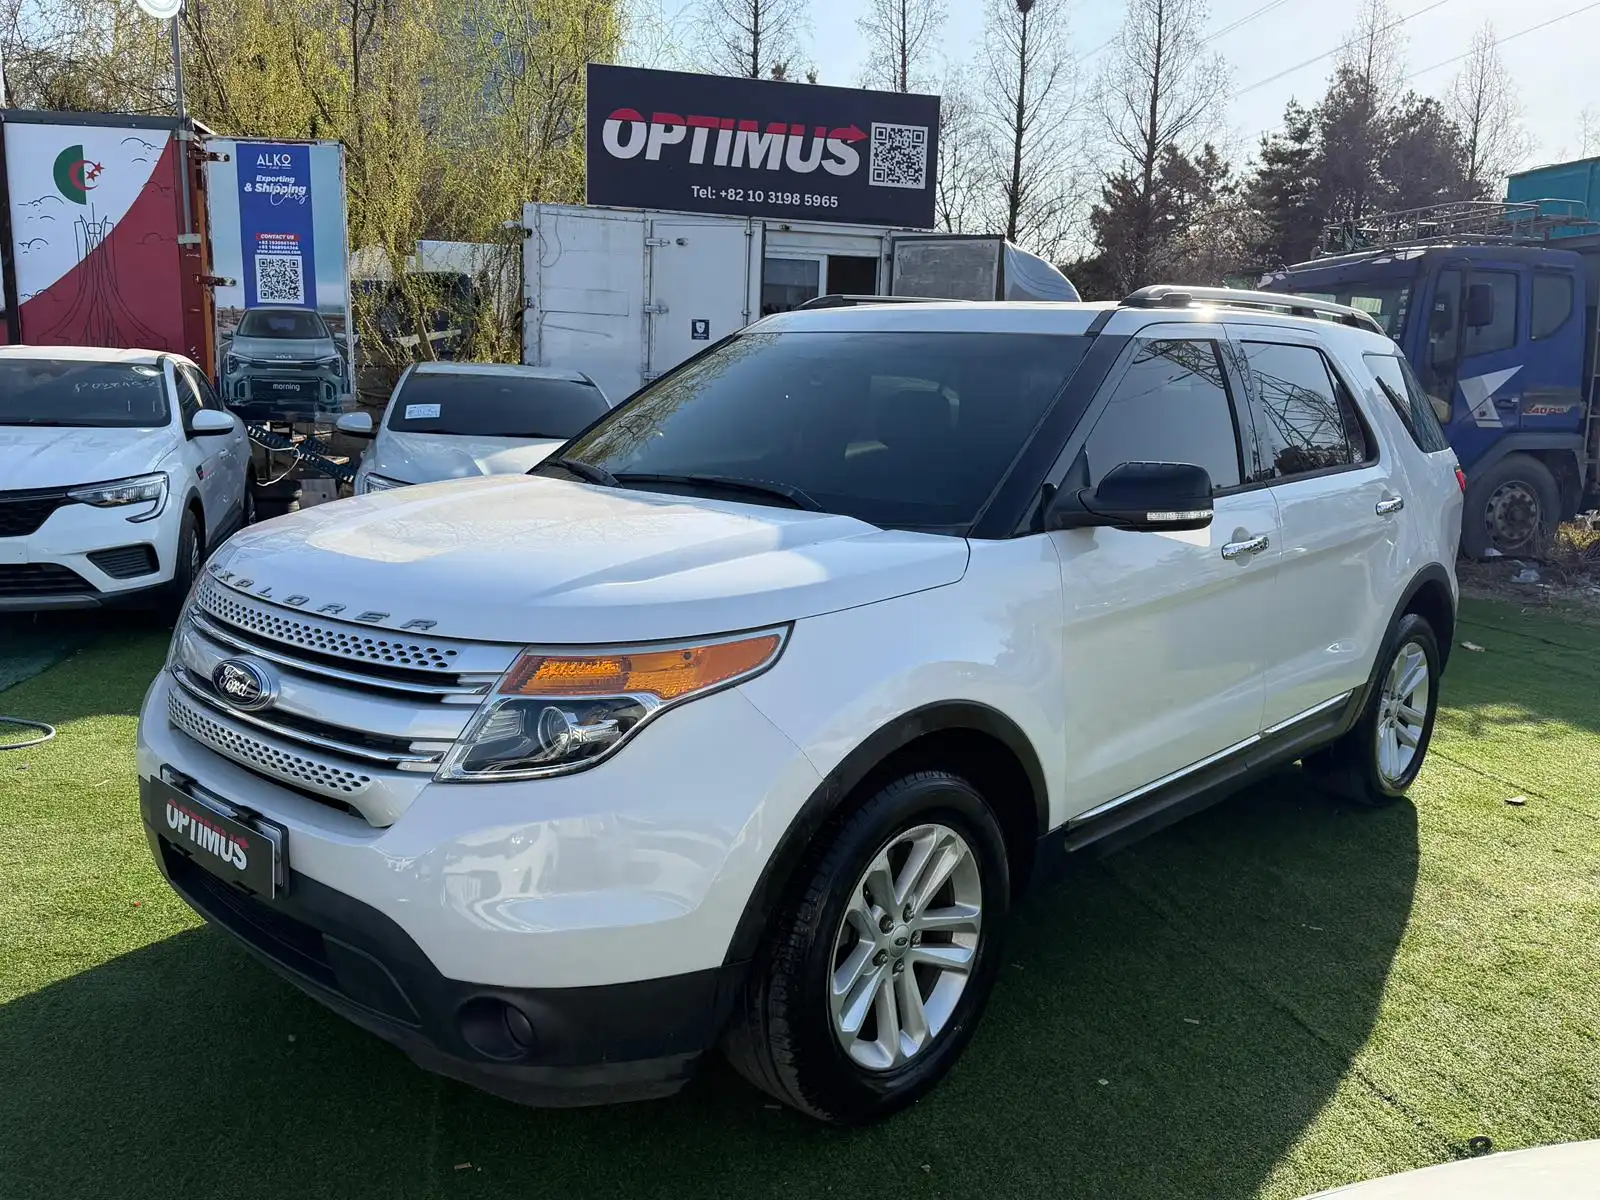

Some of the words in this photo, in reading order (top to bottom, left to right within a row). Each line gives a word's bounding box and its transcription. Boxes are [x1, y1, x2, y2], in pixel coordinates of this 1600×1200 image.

[602, 107, 861, 177] OPTIMUS
[256, 153, 291, 167] ALKO
[244, 182, 252, 192] &
[255, 183, 306, 195] Shipping
[256, 175, 295, 183] Exporting
[691, 185, 716, 199] Tel:
[719, 188, 744, 201] +82
[747, 190, 764, 203] 10
[767, 191, 801, 206] 3198
[804, 193, 839, 208] 5965
[272, 383, 301, 392] morning
[209, 562, 438, 631] EXPLORER
[219, 663, 251, 697] Ford
[166, 797, 249, 871] OPTIMUS
